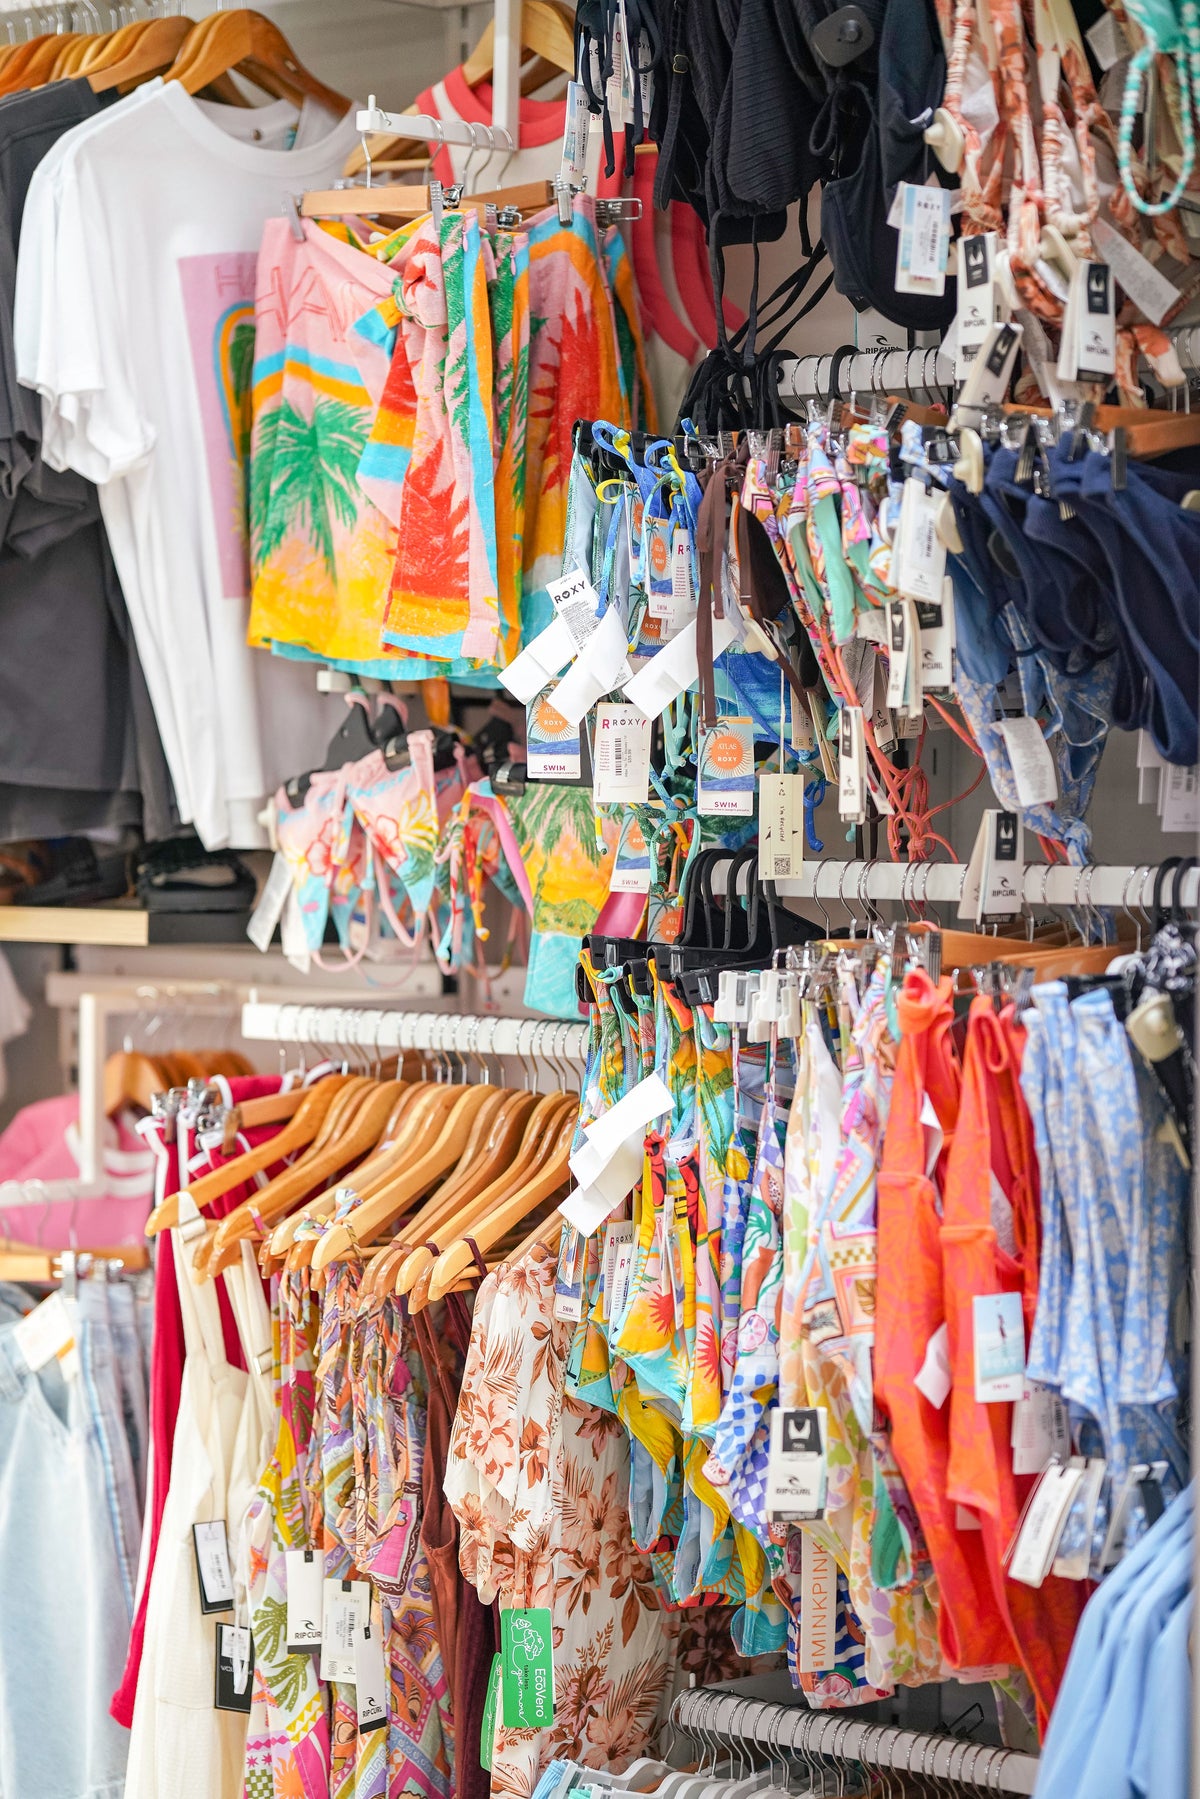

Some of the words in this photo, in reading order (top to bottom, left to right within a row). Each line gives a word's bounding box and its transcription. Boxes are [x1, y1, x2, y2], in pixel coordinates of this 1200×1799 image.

[554, 580, 586, 604] ROXY
[612, 718, 640, 726] ROXY
[616, 1233, 633, 1243] ROXY
[812, 1541, 828, 1657] MINKPINK
[294, 1631, 307, 1639] RIP
[307, 1631, 322, 1639] CUR
[511, 1668, 525, 1687] give
[535, 1668, 547, 1717] EcoVero
[362, 1710, 371, 1718] RIP
[371, 1706, 383, 1716] CURL
